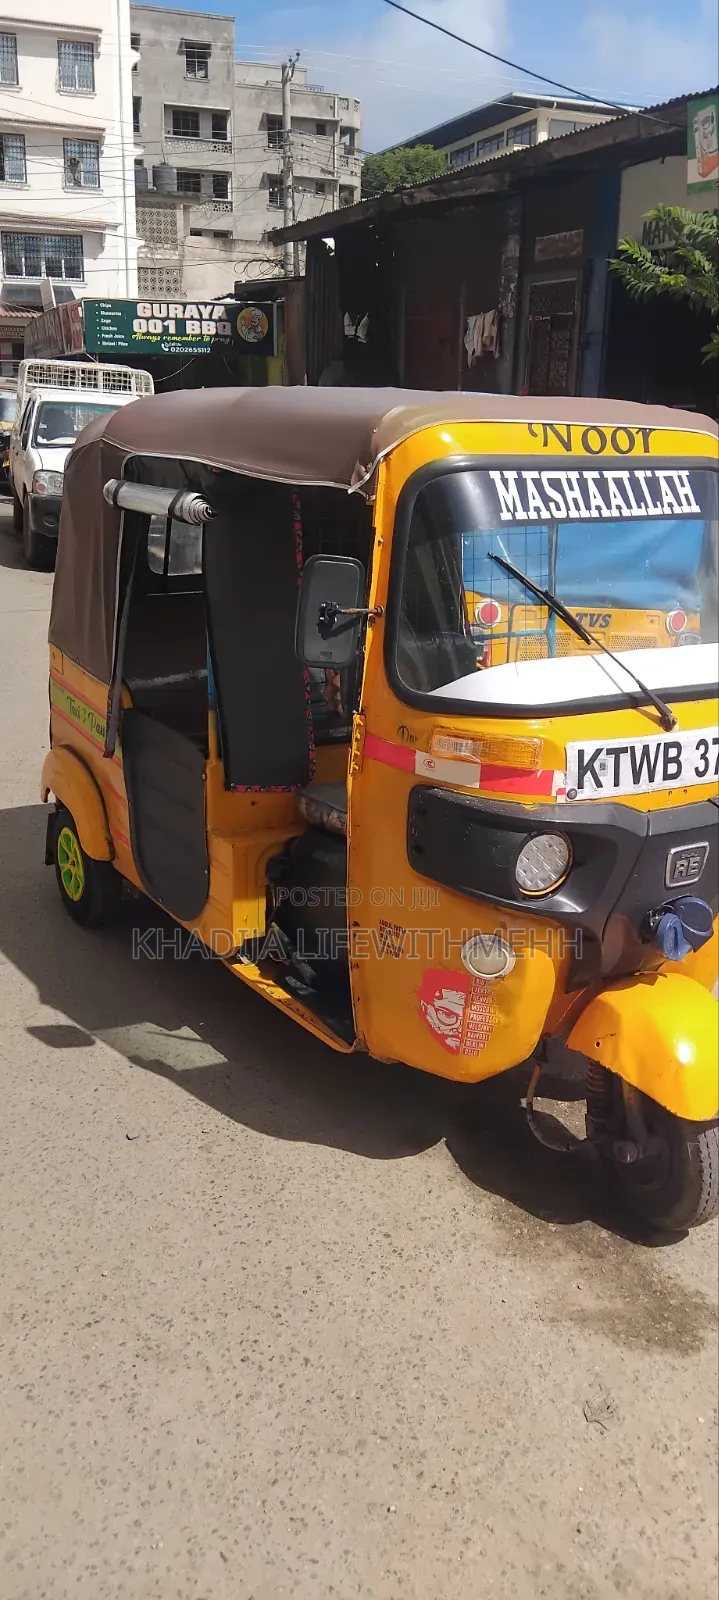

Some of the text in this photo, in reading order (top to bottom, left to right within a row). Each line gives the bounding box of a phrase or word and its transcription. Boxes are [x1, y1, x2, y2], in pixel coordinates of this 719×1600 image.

[136, 303, 228, 320] GURAYA
[132, 319, 232, 336] 001 BBQ
[132, 333, 160, 342] Always
[163, 334, 202, 342] remember
[528, 423, 653, 455] Noor
[488, 470, 701, 520] MASHAALLAH
[576, 612, 612, 628] TVS
[578, 741, 682, 790] KTWB
[673, 857, 700, 879] RE
[472, 1004, 496, 1014] MOSCOW
[466, 1040, 484, 1049] BERLIN
